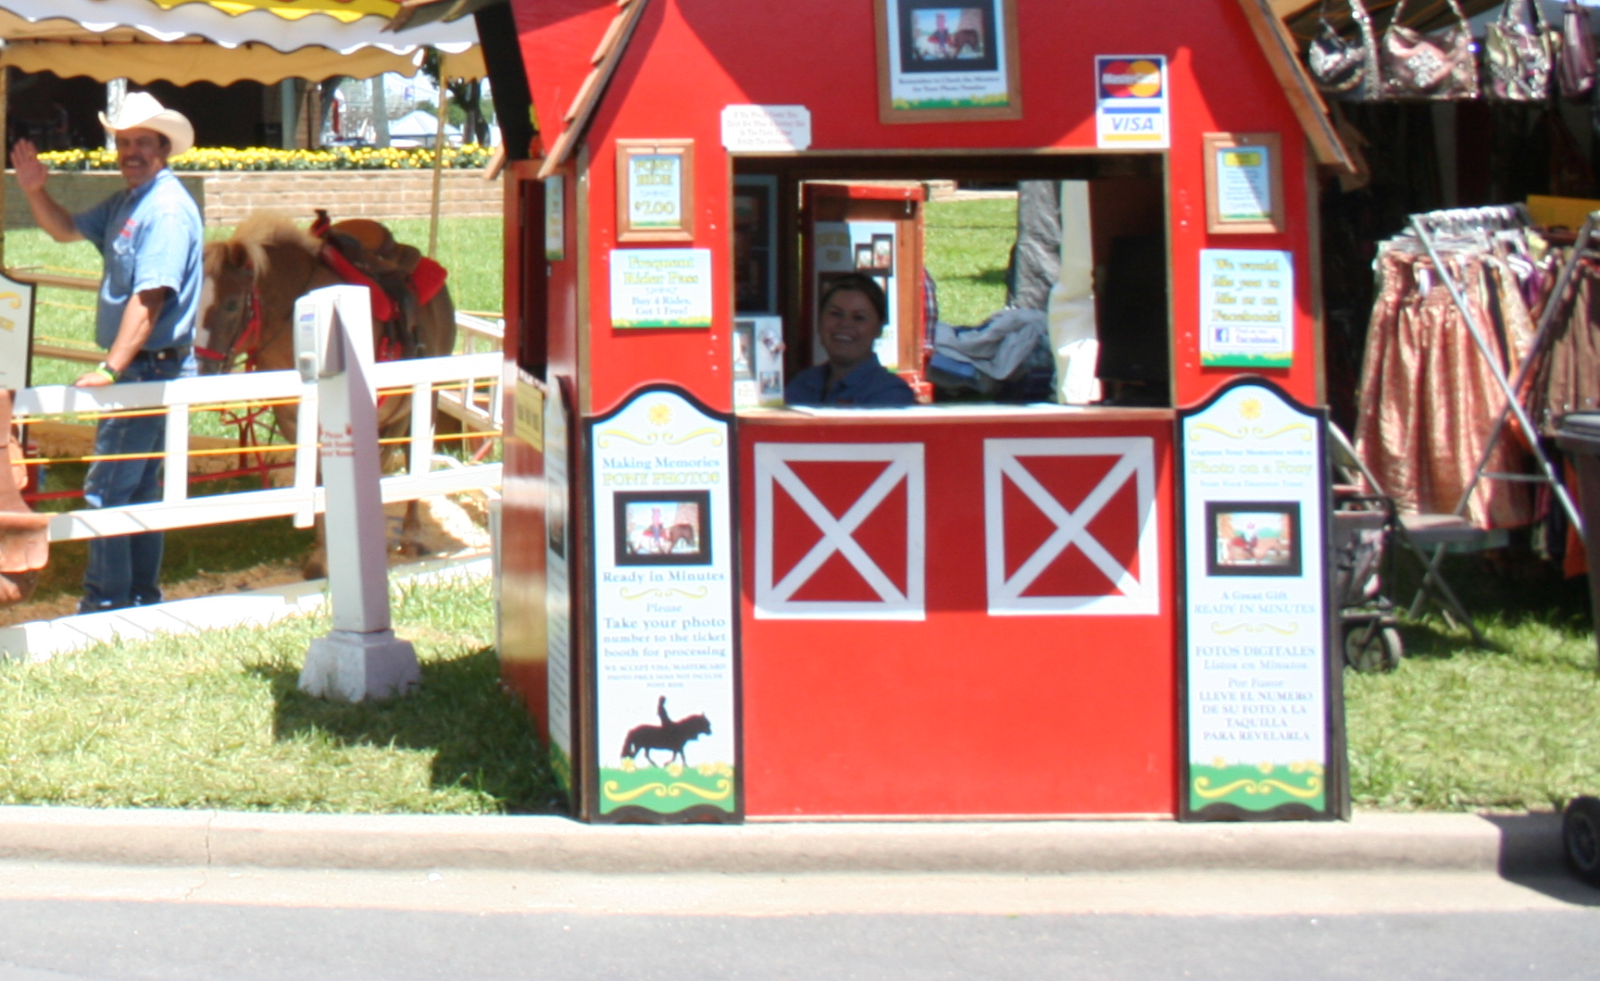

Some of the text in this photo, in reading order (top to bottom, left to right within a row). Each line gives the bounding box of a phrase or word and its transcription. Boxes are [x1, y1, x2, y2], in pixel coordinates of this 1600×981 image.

[1111, 117, 1154, 132] VISA
[628, 256, 694, 271] Frequent
[1213, 258, 1279, 271] We would
[623, 271, 699, 285] Rider Pass
[1212, 275, 1280, 291] like you to
[632, 296, 650, 306] Buy
[1214, 292, 1237, 305] like
[1261, 297, 1278, 305] on
[636, 307, 653, 315] Get
[602, 456, 720, 470] Making Memories
[1190, 460, 1313, 476] Photo on a Pony
[602, 471, 720, 486] PONY PHOTOS
[602, 570, 725, 585] Ready in Minutes
[1221, 590, 1288, 600] A Great Gift
[646, 602, 683, 613] Please
[1194, 603, 1316, 614] READY IN MINUTES
[603, 616, 726, 631] Take your photo
[603, 632, 726, 643] number to the ticket
[604, 646, 727, 659] booth for processing
[1195, 645, 1316, 657] FOTOS DIGITALES
[620, 663, 649, 672] ACCEPT
[1203, 659, 1308, 670] Listos en Minutos
[1228, 677, 1284, 688] Por Favor
[1199, 691, 1314, 701] LLEVE EL NUMERO
[1202, 704, 1307, 714] DE SU FOTO A LA
[1226, 717, 1288, 729] TAQUILLA
[1203, 731, 1310, 741] PARA REVELARLA
